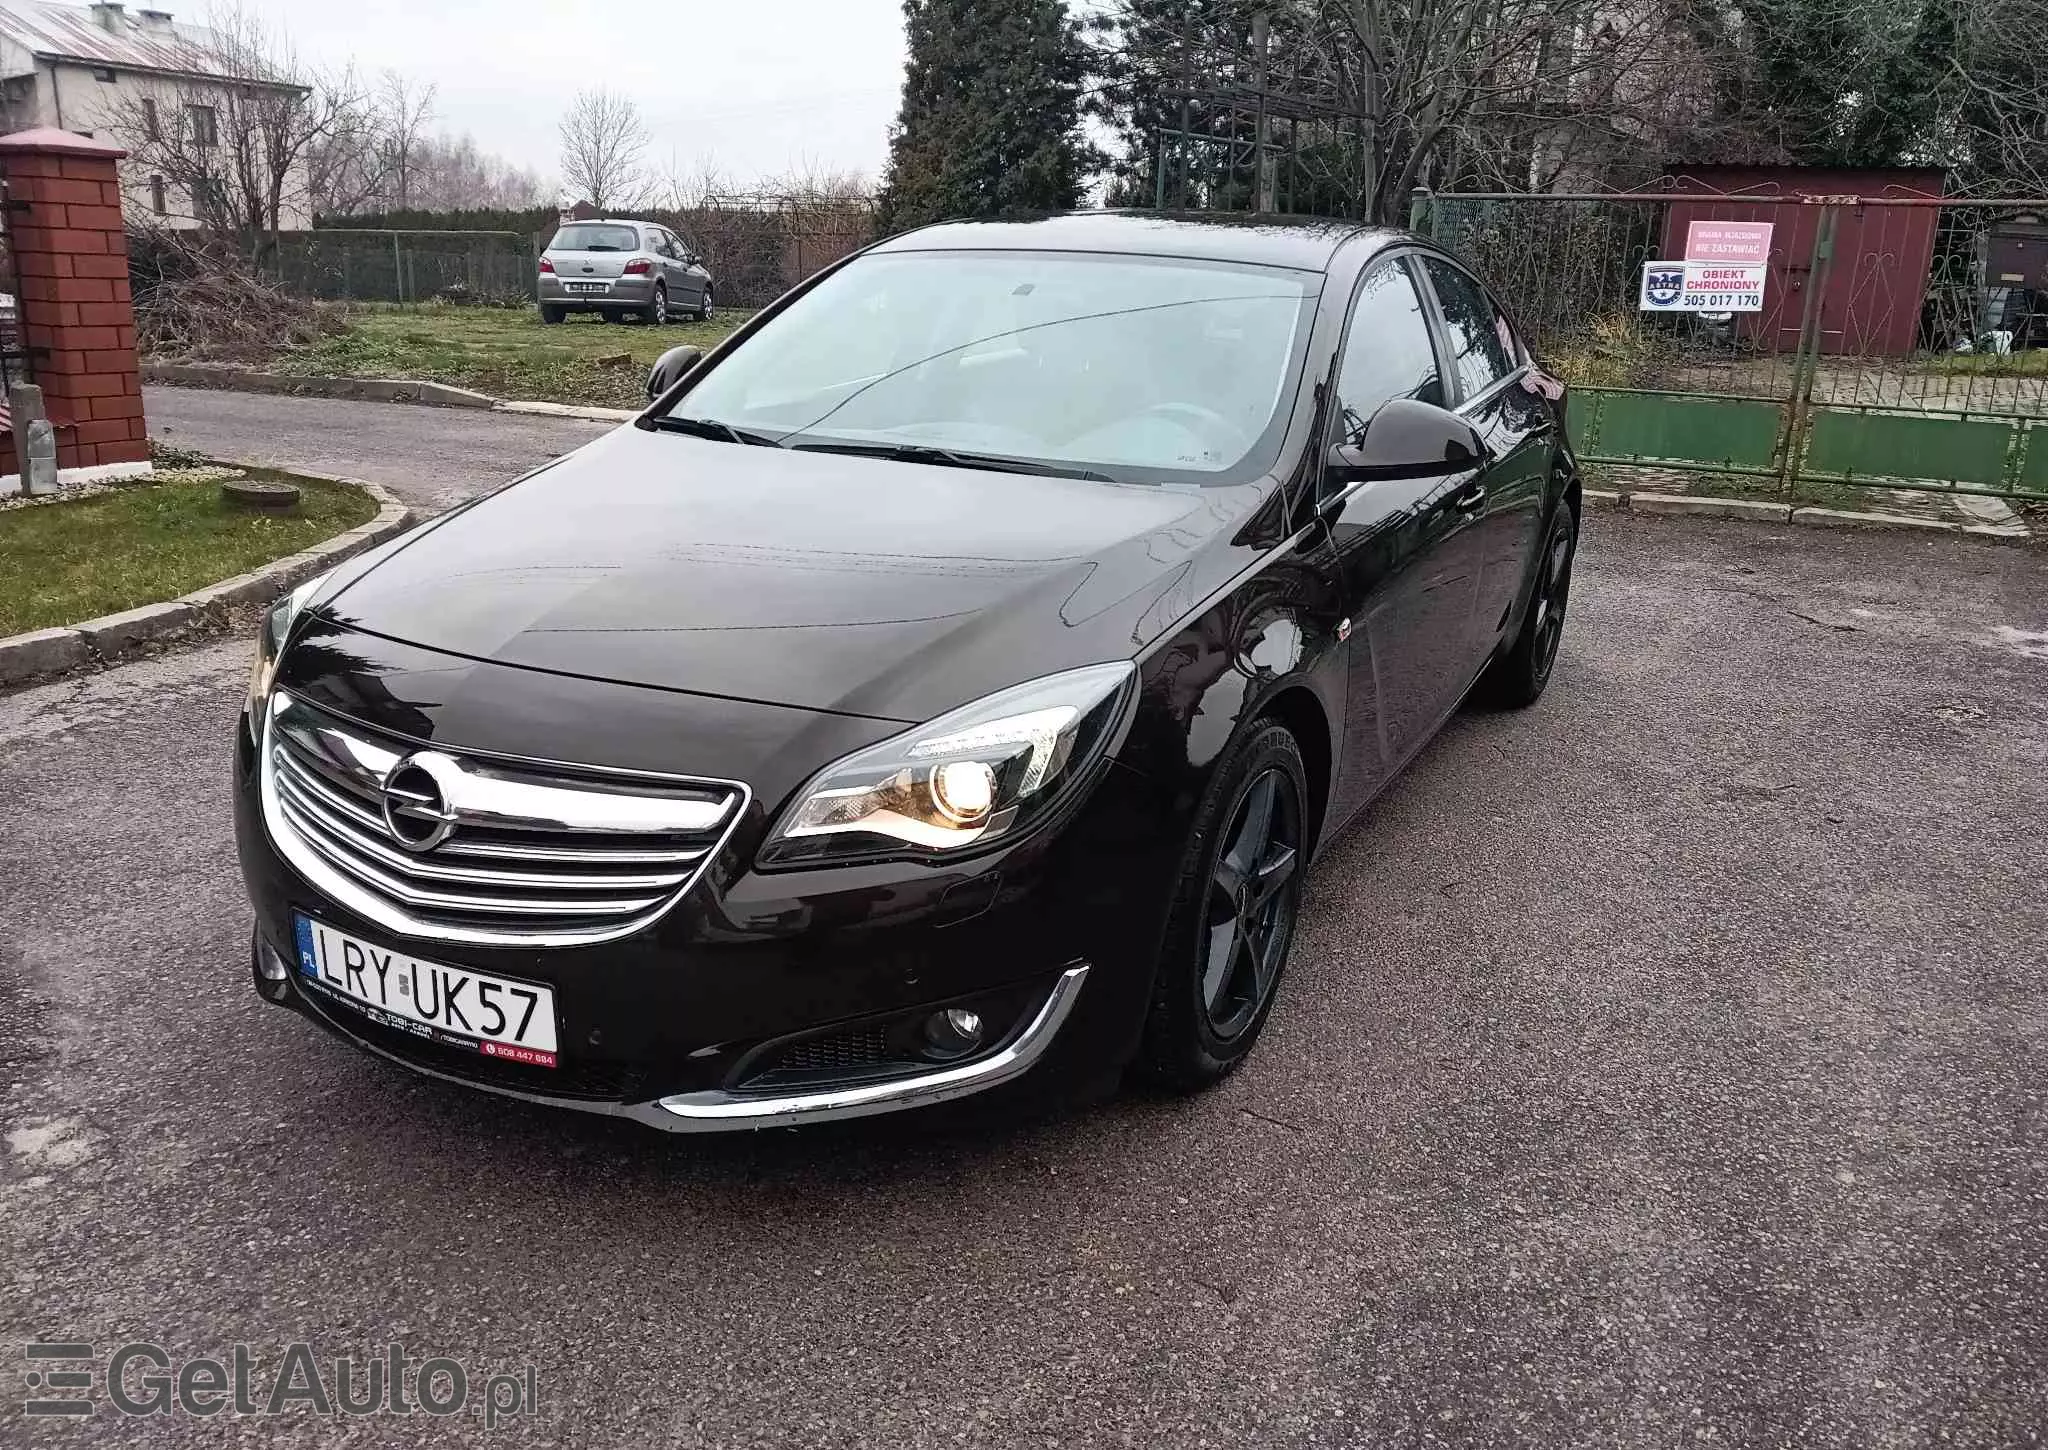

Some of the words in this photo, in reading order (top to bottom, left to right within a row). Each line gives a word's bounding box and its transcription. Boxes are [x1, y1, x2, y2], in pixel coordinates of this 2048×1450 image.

[1702, 270, 1746, 279] OBIEKT
[1686, 280, 1760, 290] CHRONIONY
[1684, 295, 1705, 306] 505
[1710, 295, 1731, 306] 017
[1737, 295, 1759, 306] 170
[302, 950, 316, 969] PL
[319, 929, 391, 1005] LRY
[411, 963, 538, 1042] UK57
[386, 1013, 433, 1035] TOBI-CAR
[497, 1047, 515, 1057] 608
[516, 1051, 534, 1060] 447
